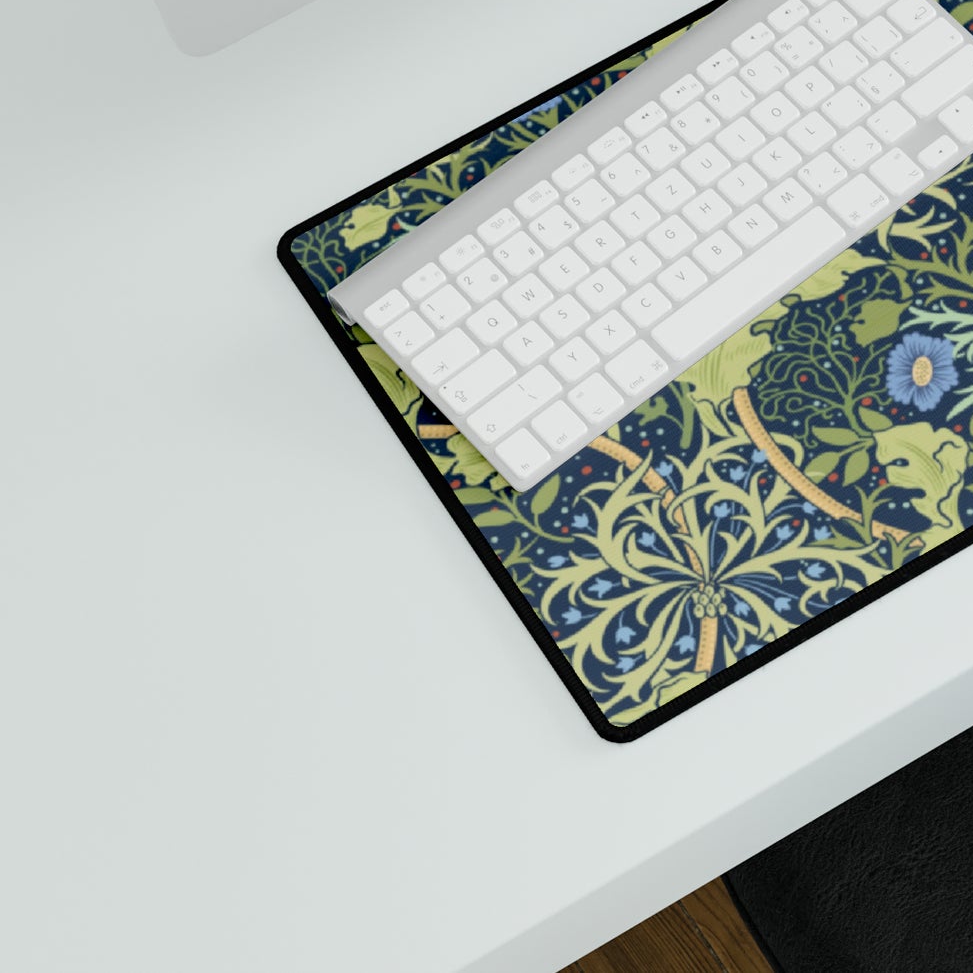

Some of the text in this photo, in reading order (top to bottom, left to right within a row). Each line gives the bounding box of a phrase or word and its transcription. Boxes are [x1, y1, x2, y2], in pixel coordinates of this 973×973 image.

[746, 68, 757, 78] 0
[804, 81, 814, 92] P
[711, 93, 721, 104] 9
[770, 107, 783, 118] O
[676, 119, 687, 129] 8
[804, 126, 817, 136] L
[737, 133, 747, 143] I
[640, 144, 651, 155] 7
[769, 149, 783, 162] K
[699, 157, 713, 170] U
[607, 171, 617, 180] 6
[736, 176, 745, 188] J
[665, 183, 678, 196] Z
[570, 195, 582, 207] 5
[780, 191, 795, 204] M
[698, 202, 712, 215] H
[630, 210, 641, 220] T
[537, 222, 547, 232] 4
[744, 217, 760, 230] N
[664, 228, 677, 240] G
[594, 236, 608, 248] R
[499, 249, 510, 259] 3
[710, 244, 723, 256] B
[628, 254, 638, 267] F
[559, 263, 571, 275] E
[463, 275, 475, 286] 2
[674, 270, 686, 281] V
[592, 282, 605, 294] D
[520, 288, 536, 302] W
[378, 301, 392, 312] esc
[425, 303, 436, 312] 1
[640, 297, 652, 308] C
[557, 309, 568, 320] S
[486, 317, 500, 328] Q
[602, 324, 617, 337] X
[521, 336, 534, 348] A
[566, 350, 578, 362] Y
[555, 432, 568, 445] ctrl
